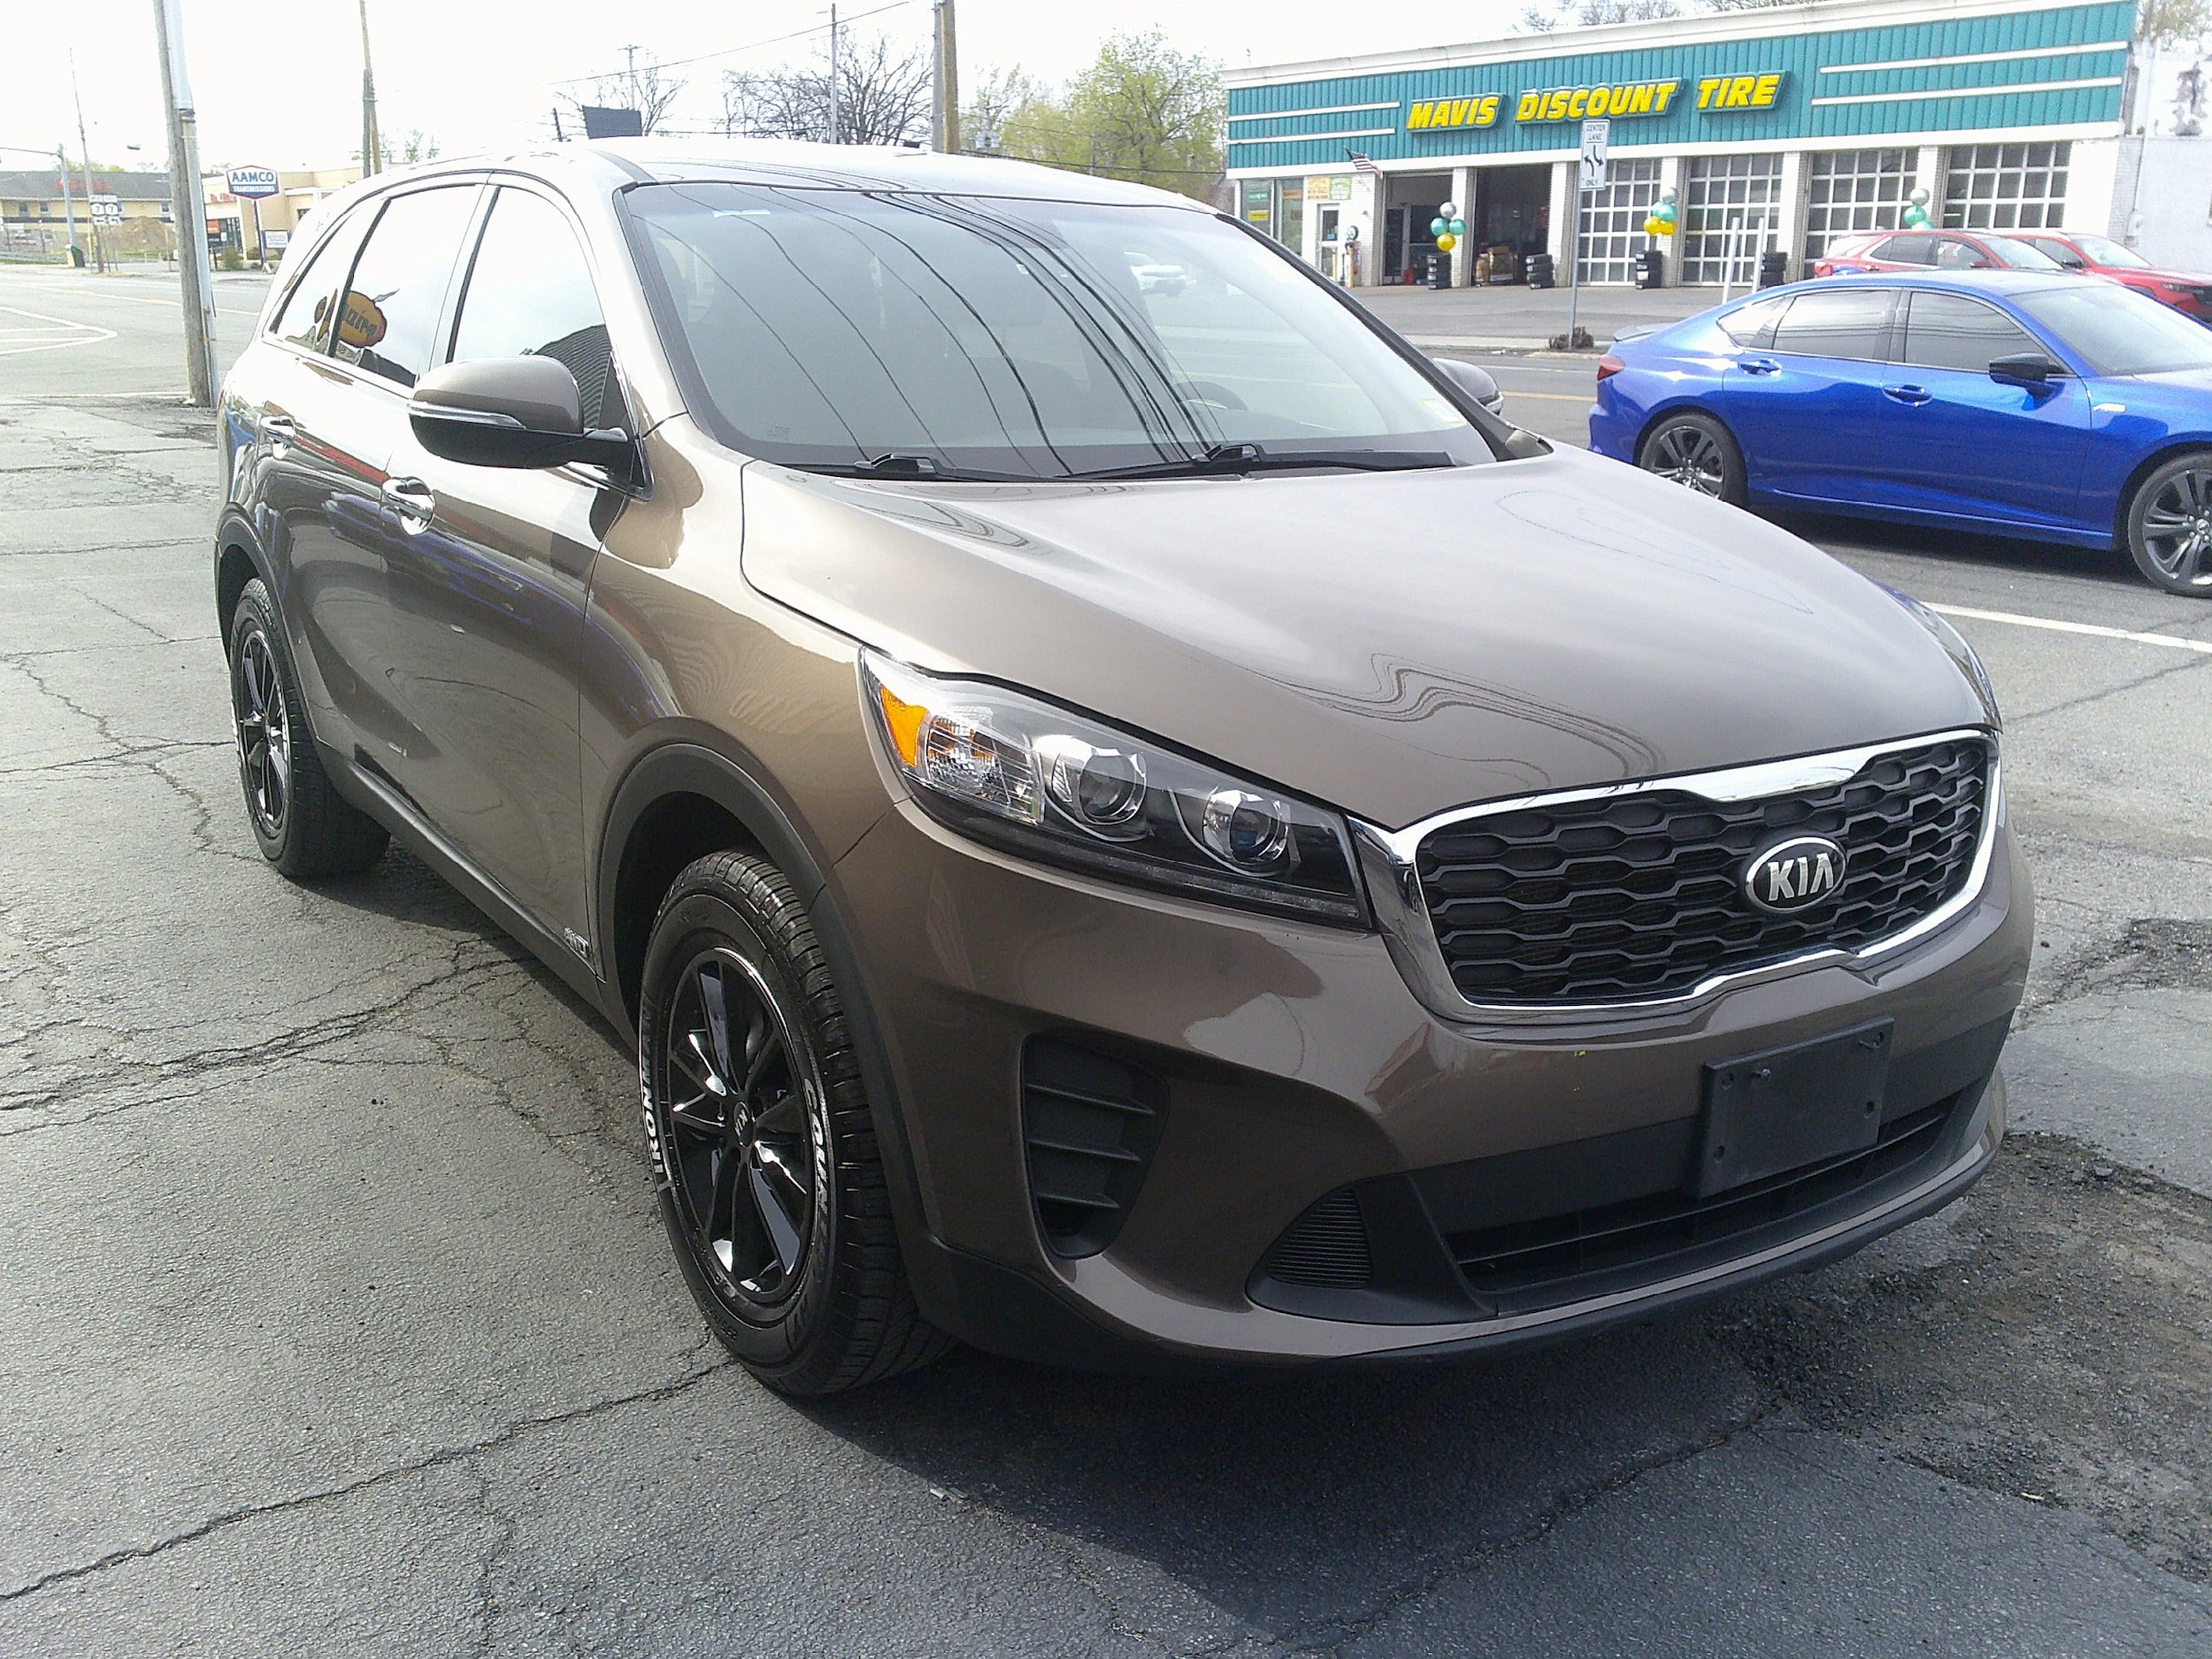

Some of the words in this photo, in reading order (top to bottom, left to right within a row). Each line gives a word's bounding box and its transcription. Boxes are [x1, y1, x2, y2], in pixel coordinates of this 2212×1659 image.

[1406, 95, 1500, 130] MAVIS
[1515, 81, 1678, 122] DISCOUNT
[1696, 73, 1781, 110] TIRE
[232, 172, 274, 182] AAMCO
[1768, 852, 1834, 901] KIA
